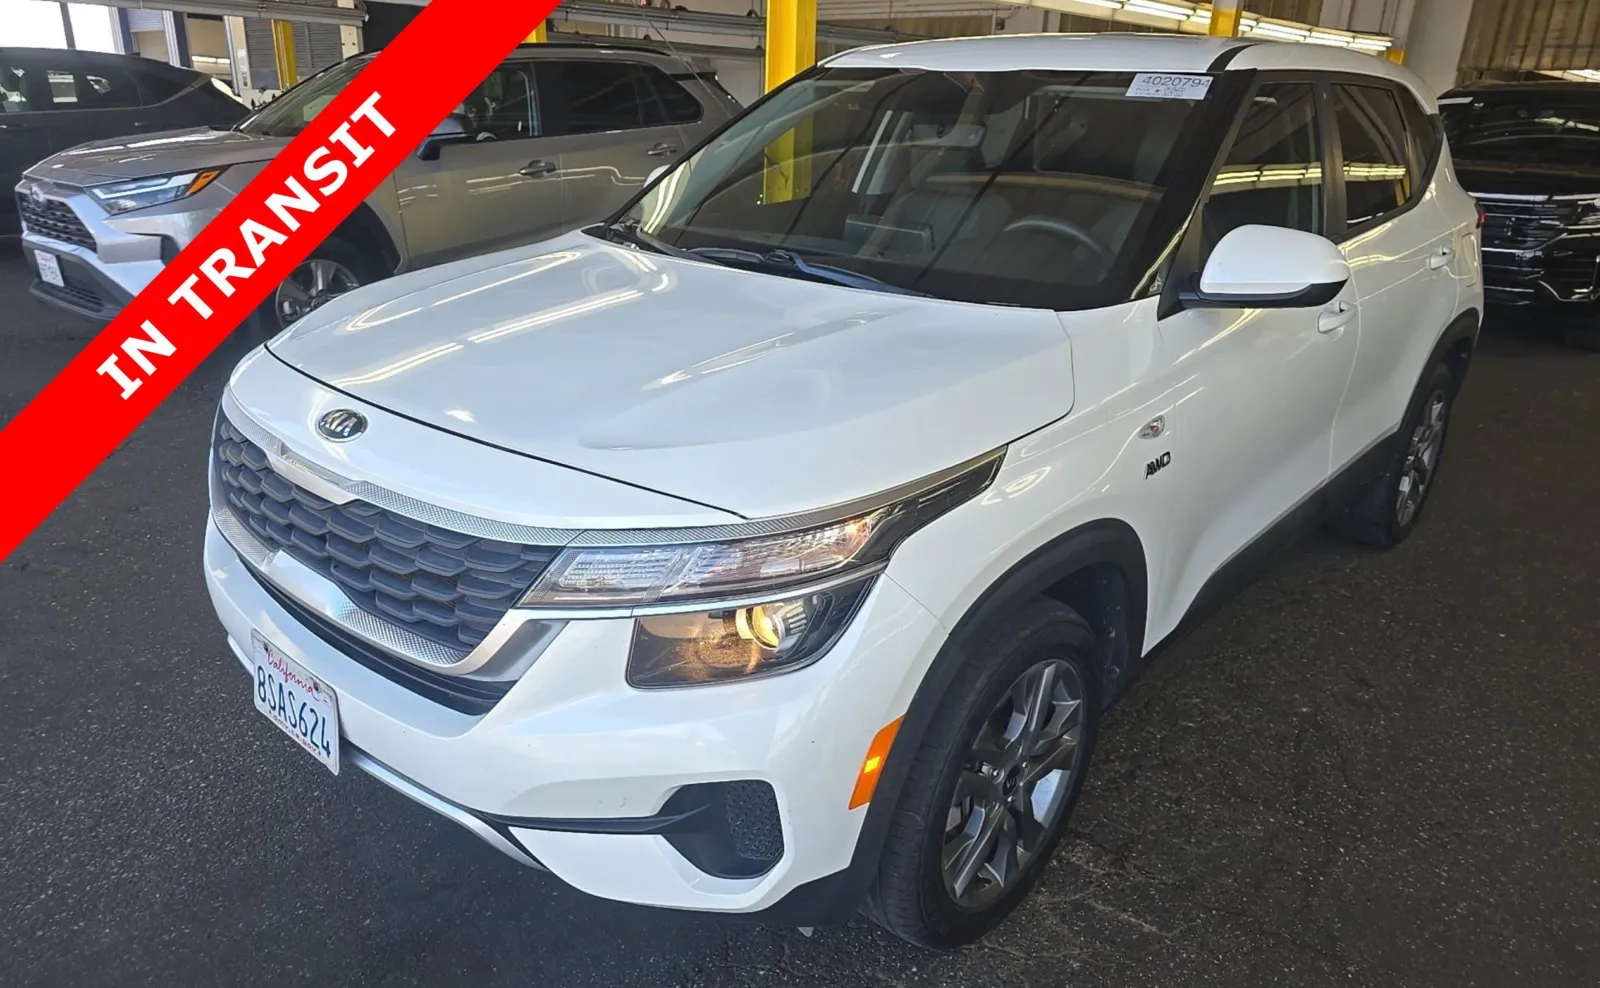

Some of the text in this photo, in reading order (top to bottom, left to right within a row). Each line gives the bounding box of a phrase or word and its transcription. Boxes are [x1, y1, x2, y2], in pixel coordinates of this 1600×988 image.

[1142, 76, 1210, 88] 4020794
[319, 410, 361, 439] KIA
[1144, 451, 1171, 480] AWD
[268, 650, 317, 699] California
[257, 665, 331, 758] 8SAS624
